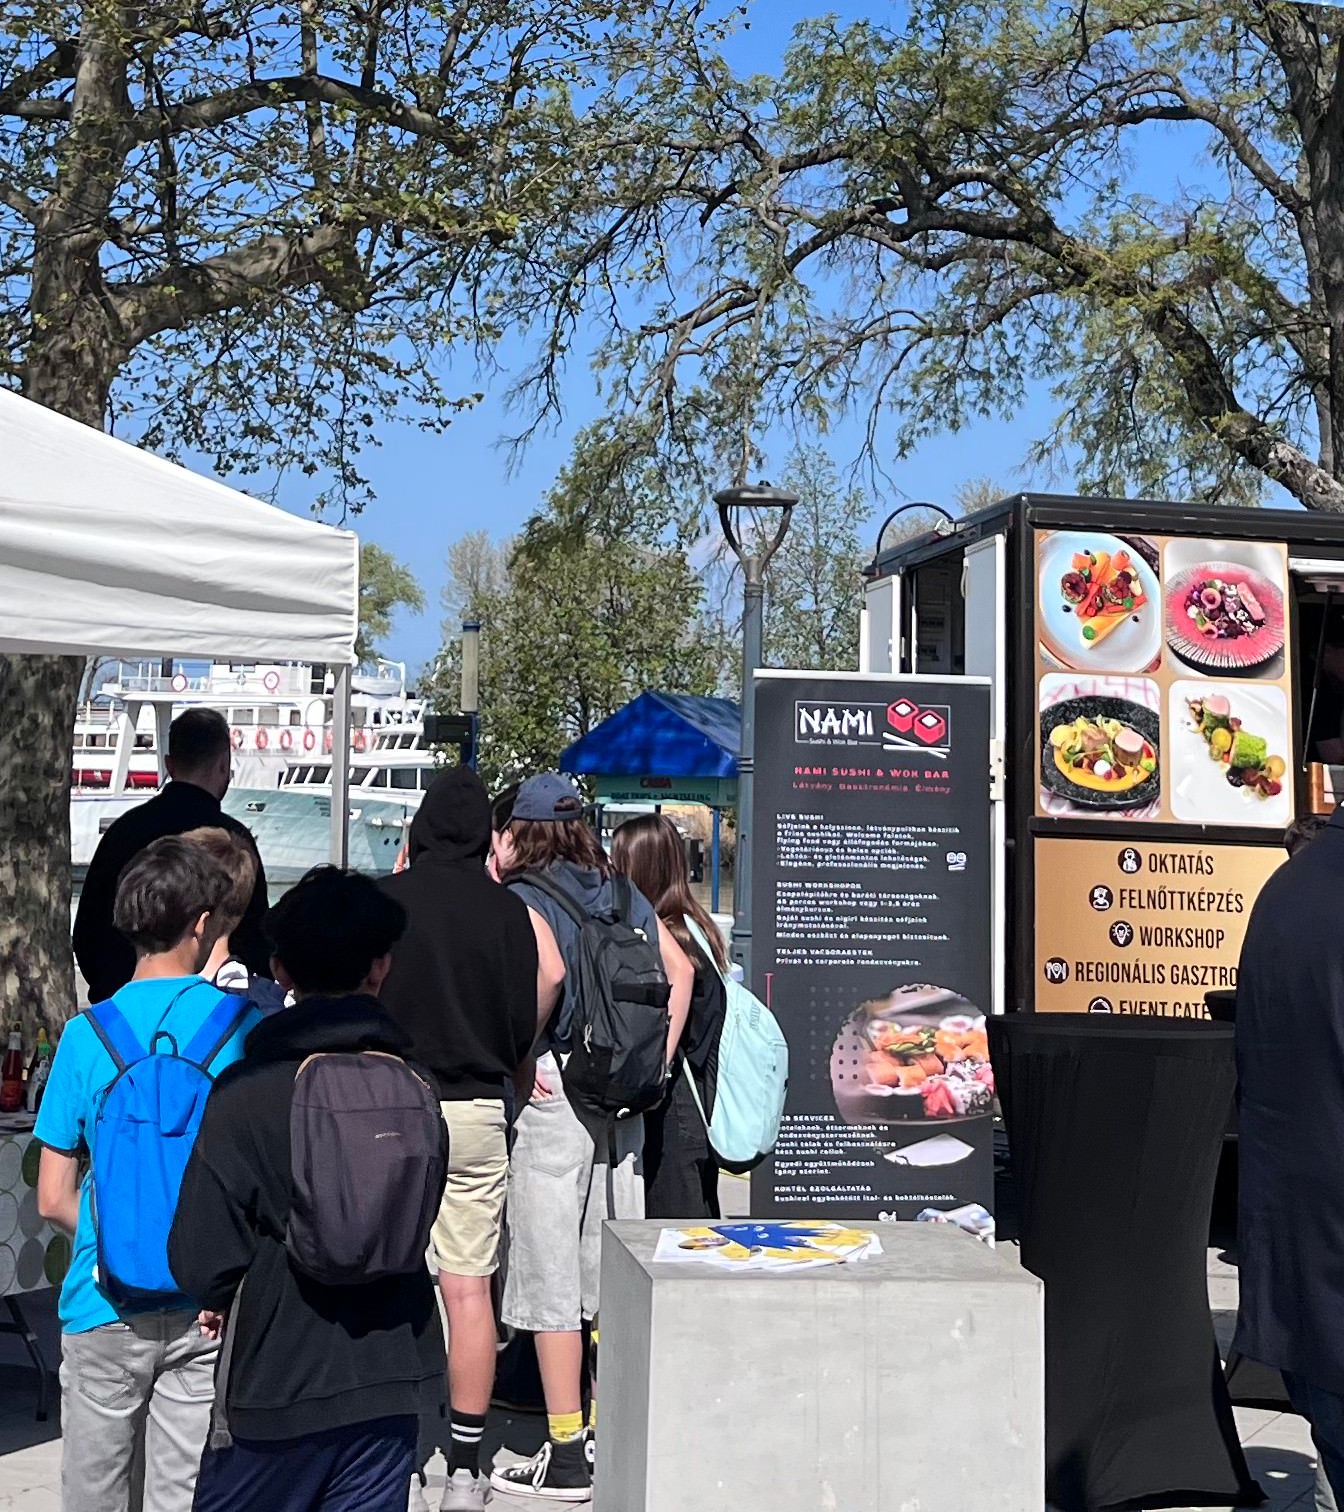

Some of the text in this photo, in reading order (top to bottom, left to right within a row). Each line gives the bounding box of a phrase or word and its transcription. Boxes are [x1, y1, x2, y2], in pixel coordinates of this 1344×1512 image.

[798, 707, 874, 736] NAMI
[794, 767, 827, 776] NAMI
[832, 768, 871, 777] SUSHI
[889, 769, 919, 778] WOK
[924, 770, 950, 779] BAR
[1148, 850, 1214, 876] OKTATÁS
[1119, 885, 1244, 913] FELNŐTTKÉPZÉS
[1140, 925, 1225, 949] WORKSHOP
[1075, 957, 1166, 985] REGIONÁLIS
